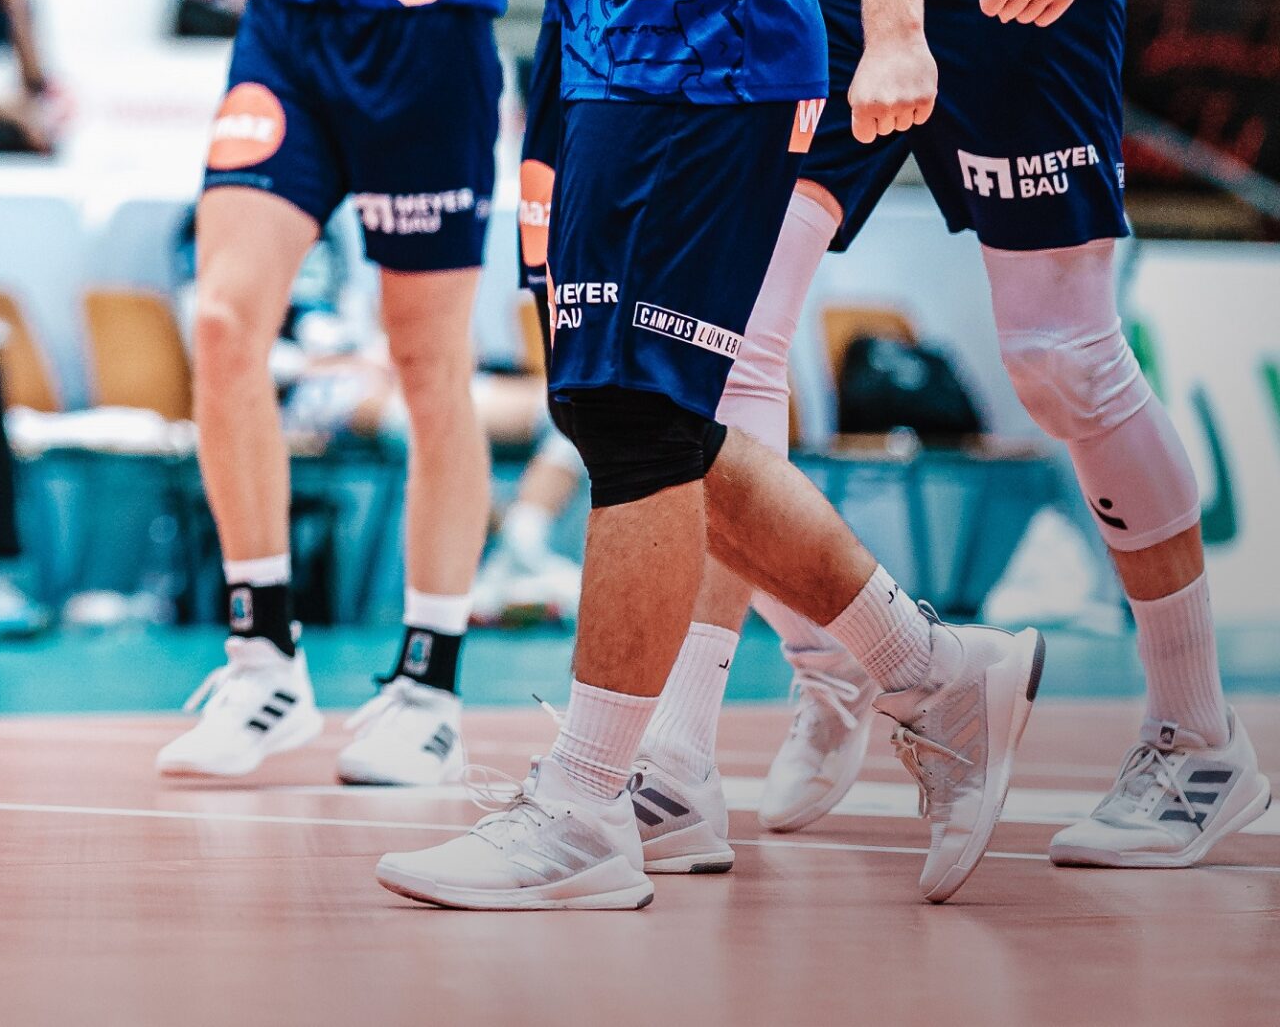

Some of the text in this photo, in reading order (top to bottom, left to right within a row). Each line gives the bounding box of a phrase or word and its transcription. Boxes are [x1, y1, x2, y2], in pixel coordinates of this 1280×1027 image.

[1016, 144, 1100, 177] MEYER
[1019, 172, 1069, 199] BAU
[556, 307, 583, 330] AU
[640, 307, 694, 339] CAMPUS
